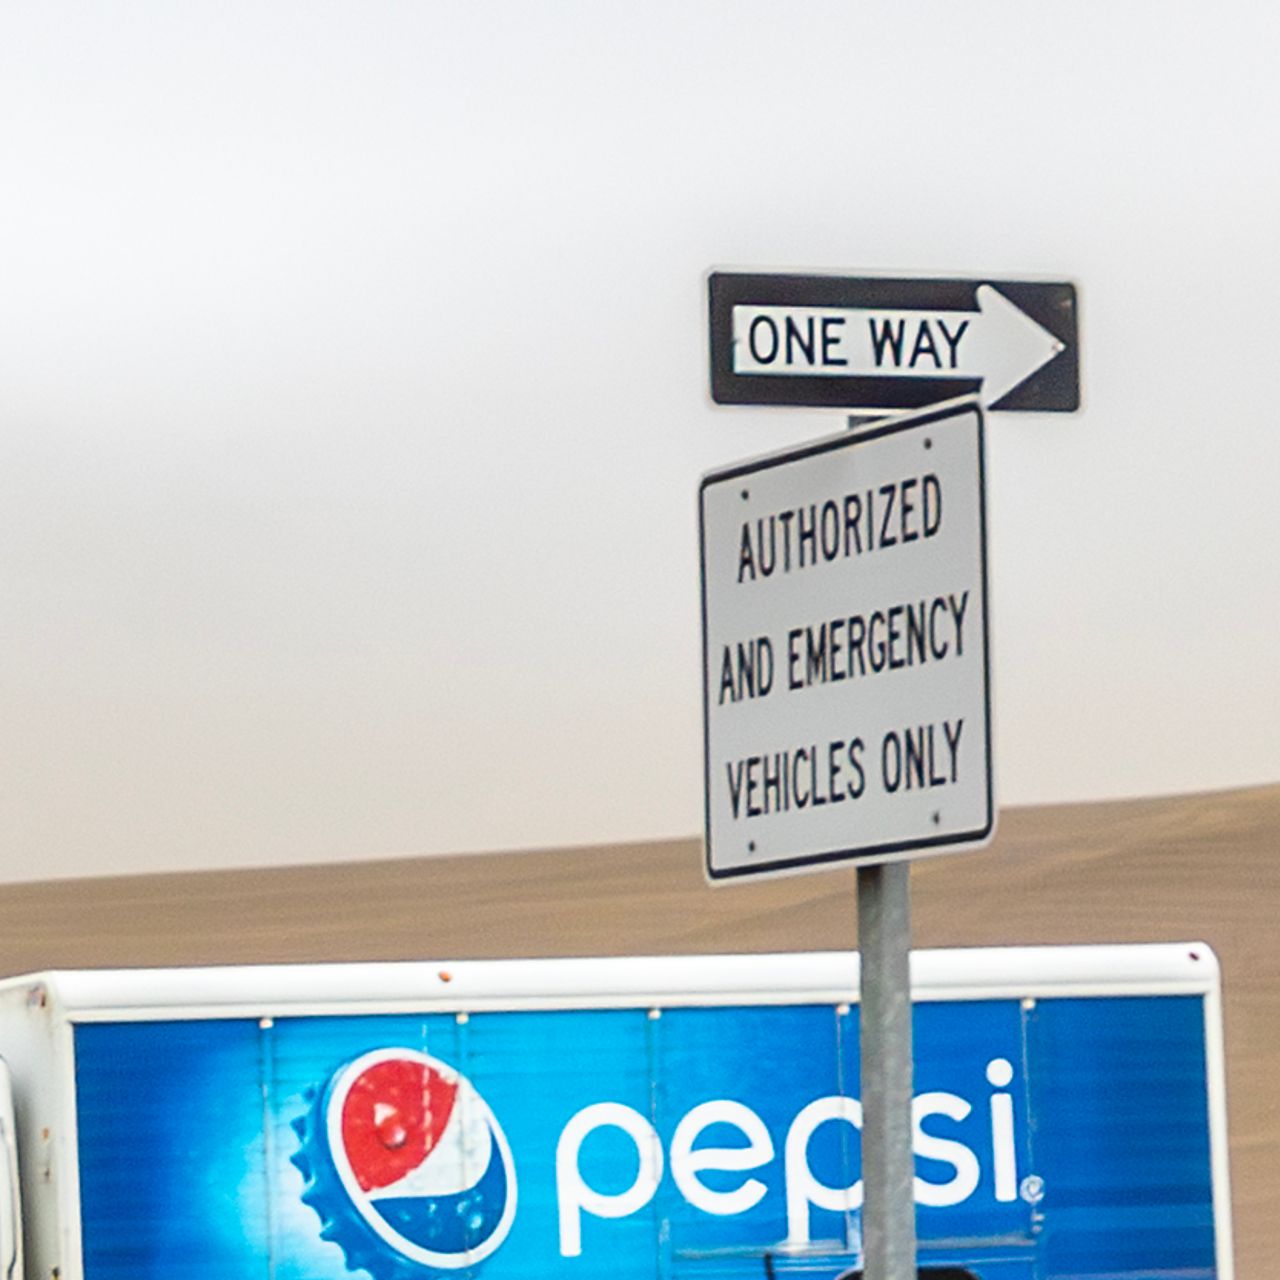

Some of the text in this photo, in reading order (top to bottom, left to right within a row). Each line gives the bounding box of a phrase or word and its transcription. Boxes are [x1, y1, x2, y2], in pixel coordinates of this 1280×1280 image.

[749, 315, 969, 369] ONE WAY
[737, 473, 942, 583] AUTHORIZED
[718, 591, 969, 706] AND EMERGENCY
[727, 718, 964, 820] VEHICLES ONLY
[556, 1058, 1018, 1257] pepsi
